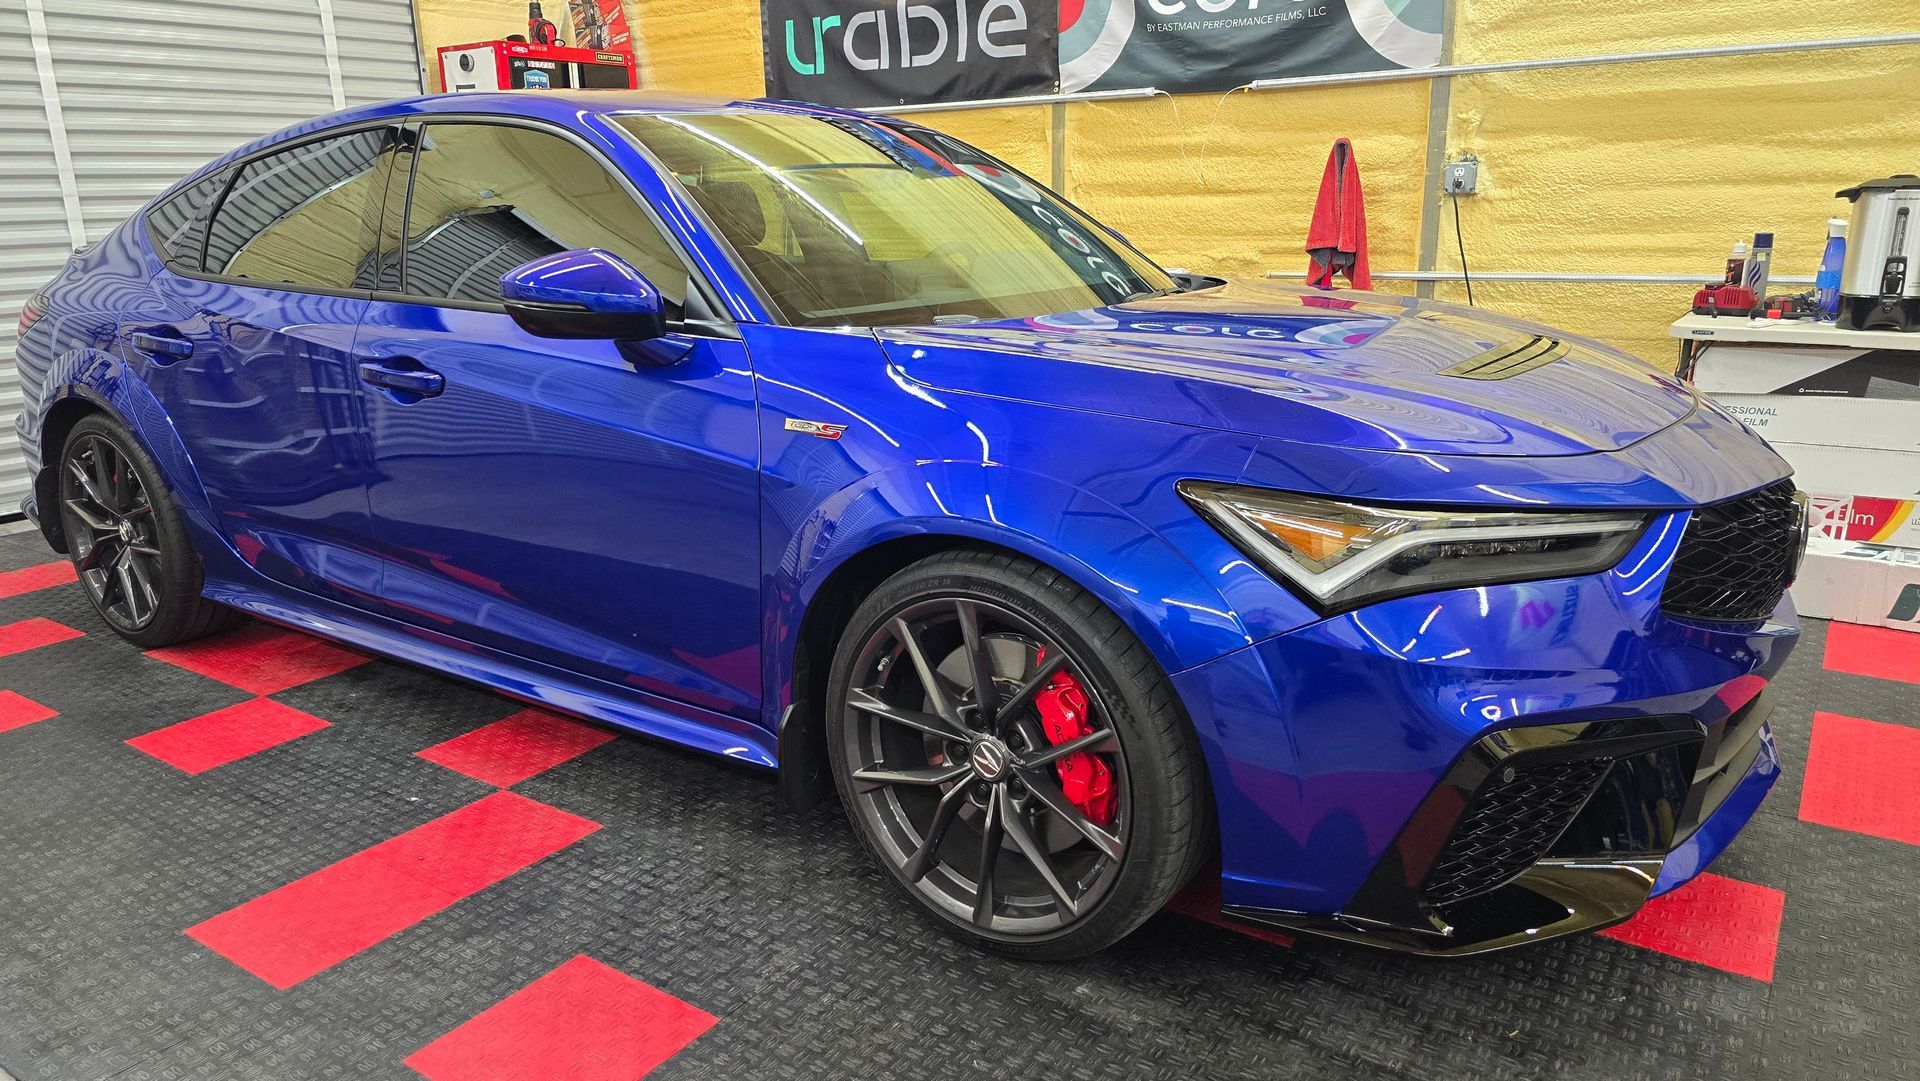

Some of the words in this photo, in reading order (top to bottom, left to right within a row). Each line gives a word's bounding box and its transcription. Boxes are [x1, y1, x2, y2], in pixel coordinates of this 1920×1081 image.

[786, 0, 1027, 75] urable
[1147, 23, 1156, 32] BY
[1158, 21, 1200, 32] EASTMAN
[1202, 14, 1273, 30] PERFORMANCE
[1275, 9, 1305, 22] FILMS,
[1307, 6, 1327, 18] LLC
[1724, 405, 1778, 416] ESSIONAL
[1055, 723, 1073, 772] ACRA
